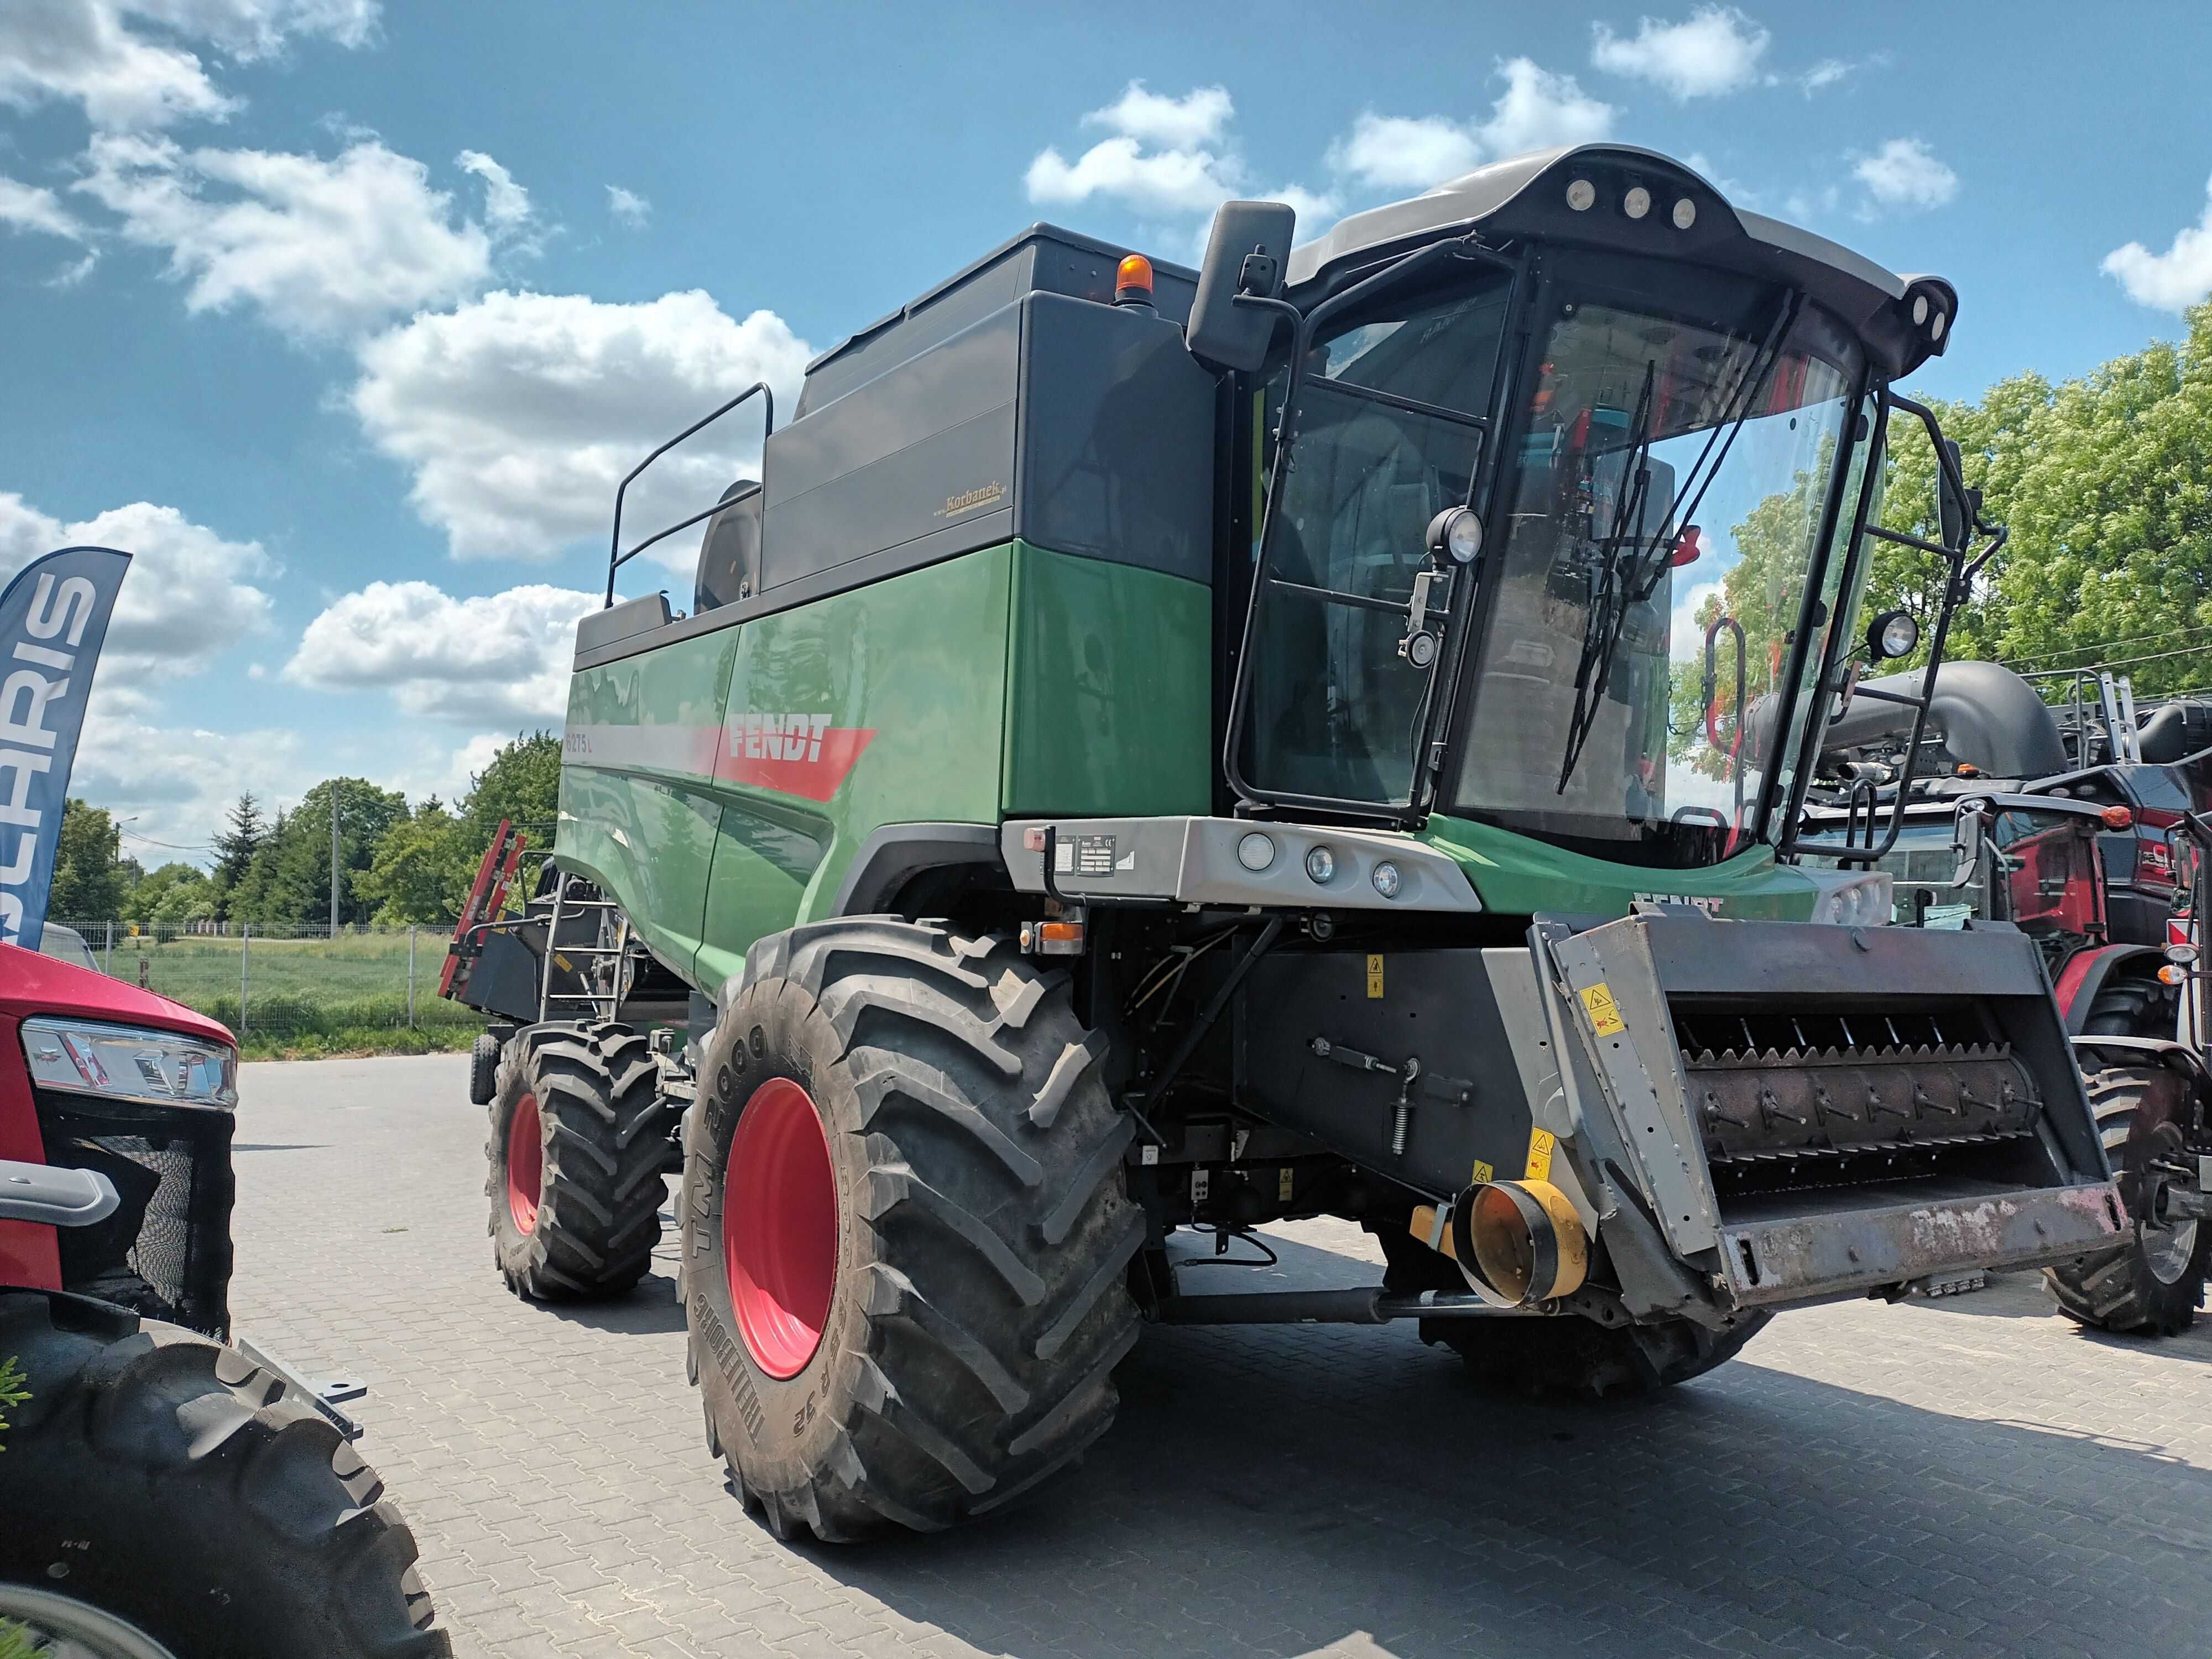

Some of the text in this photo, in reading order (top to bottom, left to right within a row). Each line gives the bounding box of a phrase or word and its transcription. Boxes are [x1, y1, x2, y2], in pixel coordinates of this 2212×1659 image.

[0, 573, 96, 947] LARIS
[566, 733, 587, 753] 6275
[728, 713, 832, 762] FENDT
[691, 1149, 713, 1259] TM
[704, 1022, 766, 1146] 2000
[693, 1292, 765, 1451] TRELLEBORG
